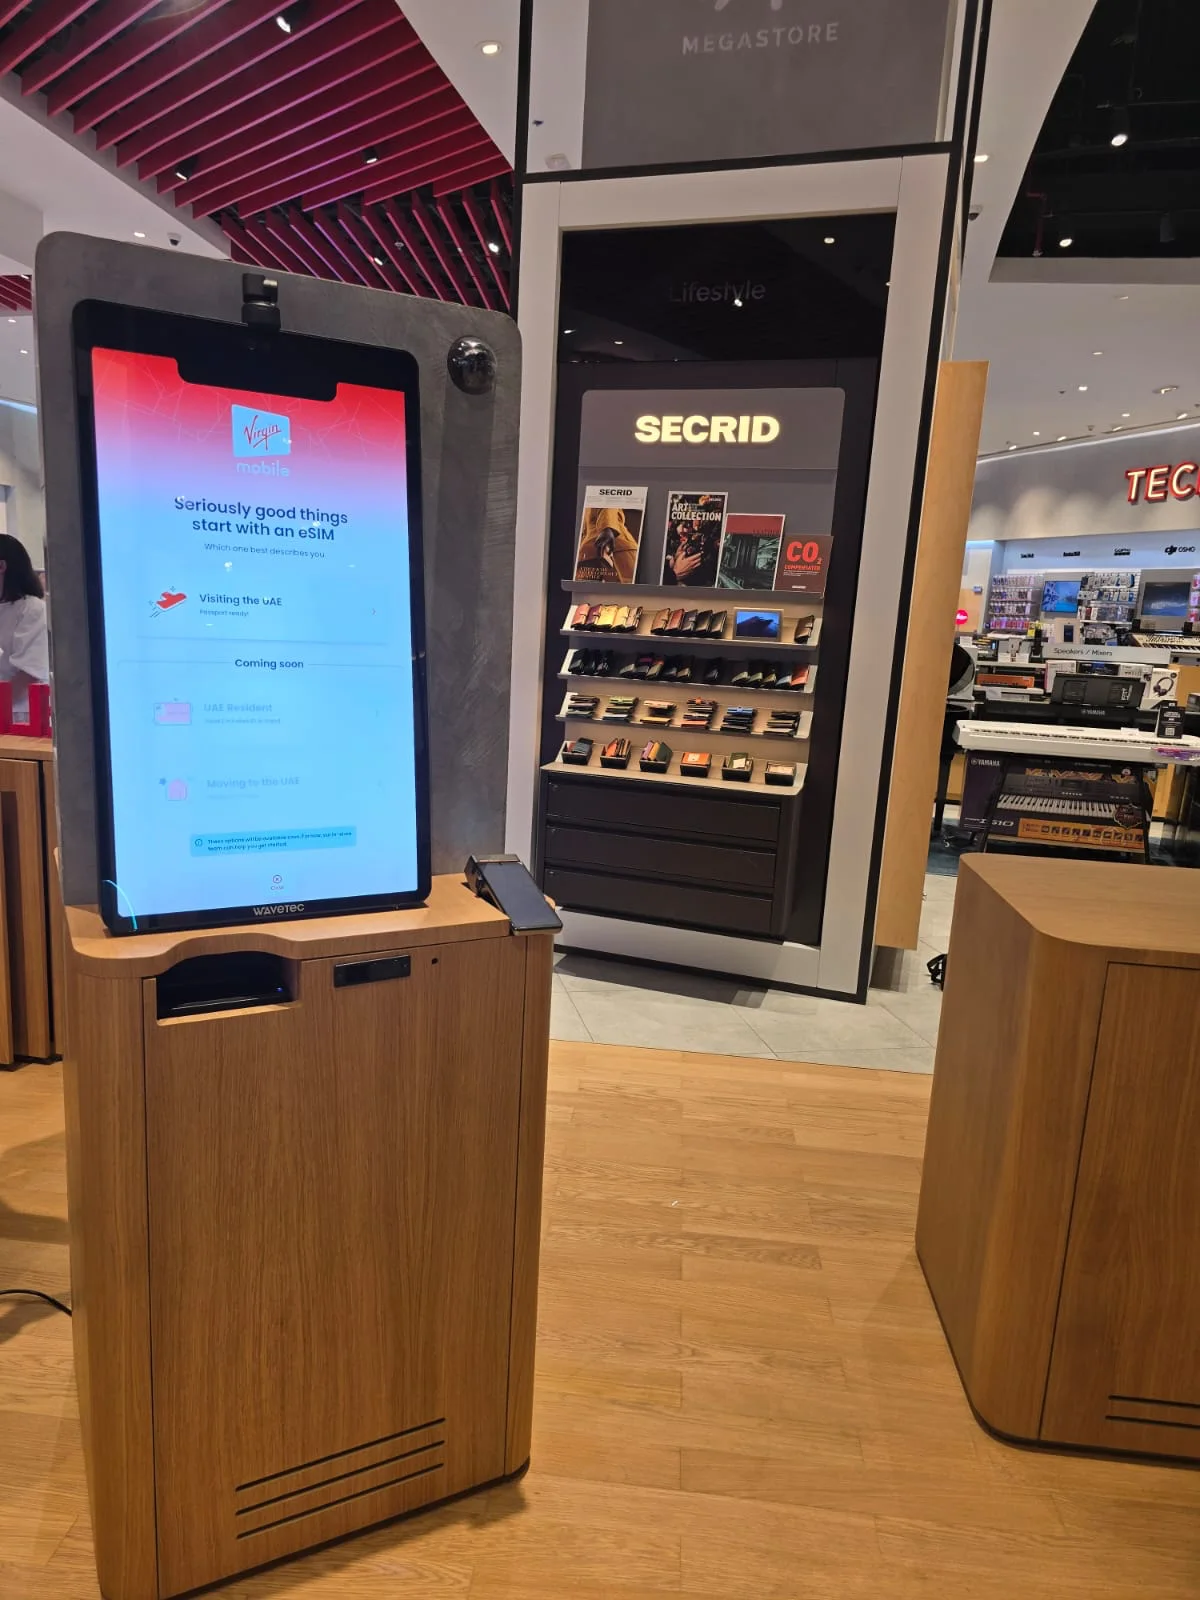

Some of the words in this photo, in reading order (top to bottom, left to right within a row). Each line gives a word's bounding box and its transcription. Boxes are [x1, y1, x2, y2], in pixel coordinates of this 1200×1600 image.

[681, 22, 839, 56] MEGASTORE
[669, 279, 767, 306] Lifestyle
[243, 414, 282, 452] Virgin
[634, 415, 781, 443] SECRID
[236, 460, 290, 477] mobile
[1125, 461, 1200, 502] TEC
[599, 488, 633, 497] SECRID
[174, 497, 251, 520] Seriously
[255, 506, 296, 521] good
[299, 508, 348, 527] things
[671, 502, 689, 512] ART
[671, 511, 722, 522] COLLECTION
[192, 518, 232, 533] start
[235, 521, 270, 536] with
[274, 526, 295, 538] an
[298, 527, 335, 541] eSIM
[204, 543, 231, 552] Which
[232, 545, 249, 553] one
[250, 546, 268, 555] best
[269, 547, 309, 558] describes
[199, 593, 240, 606] Visiting
[242, 595, 260, 605] the
[262, 596, 283, 606] UAE
[1053, 647, 1084, 656] Speakers
[1091, 649, 1113, 657] Mixers
[234, 658, 277, 670] Coming
[279, 659, 304, 669] soon
[203, 703, 225, 712] UAE
[226, 703, 273, 713] Resident
[978, 758, 1001, 767] YAMAHA
[206, 778, 247, 790] Moving
[248, 778, 260, 787] to
[261, 777, 279, 787] the
[280, 776, 301, 786] UAE
